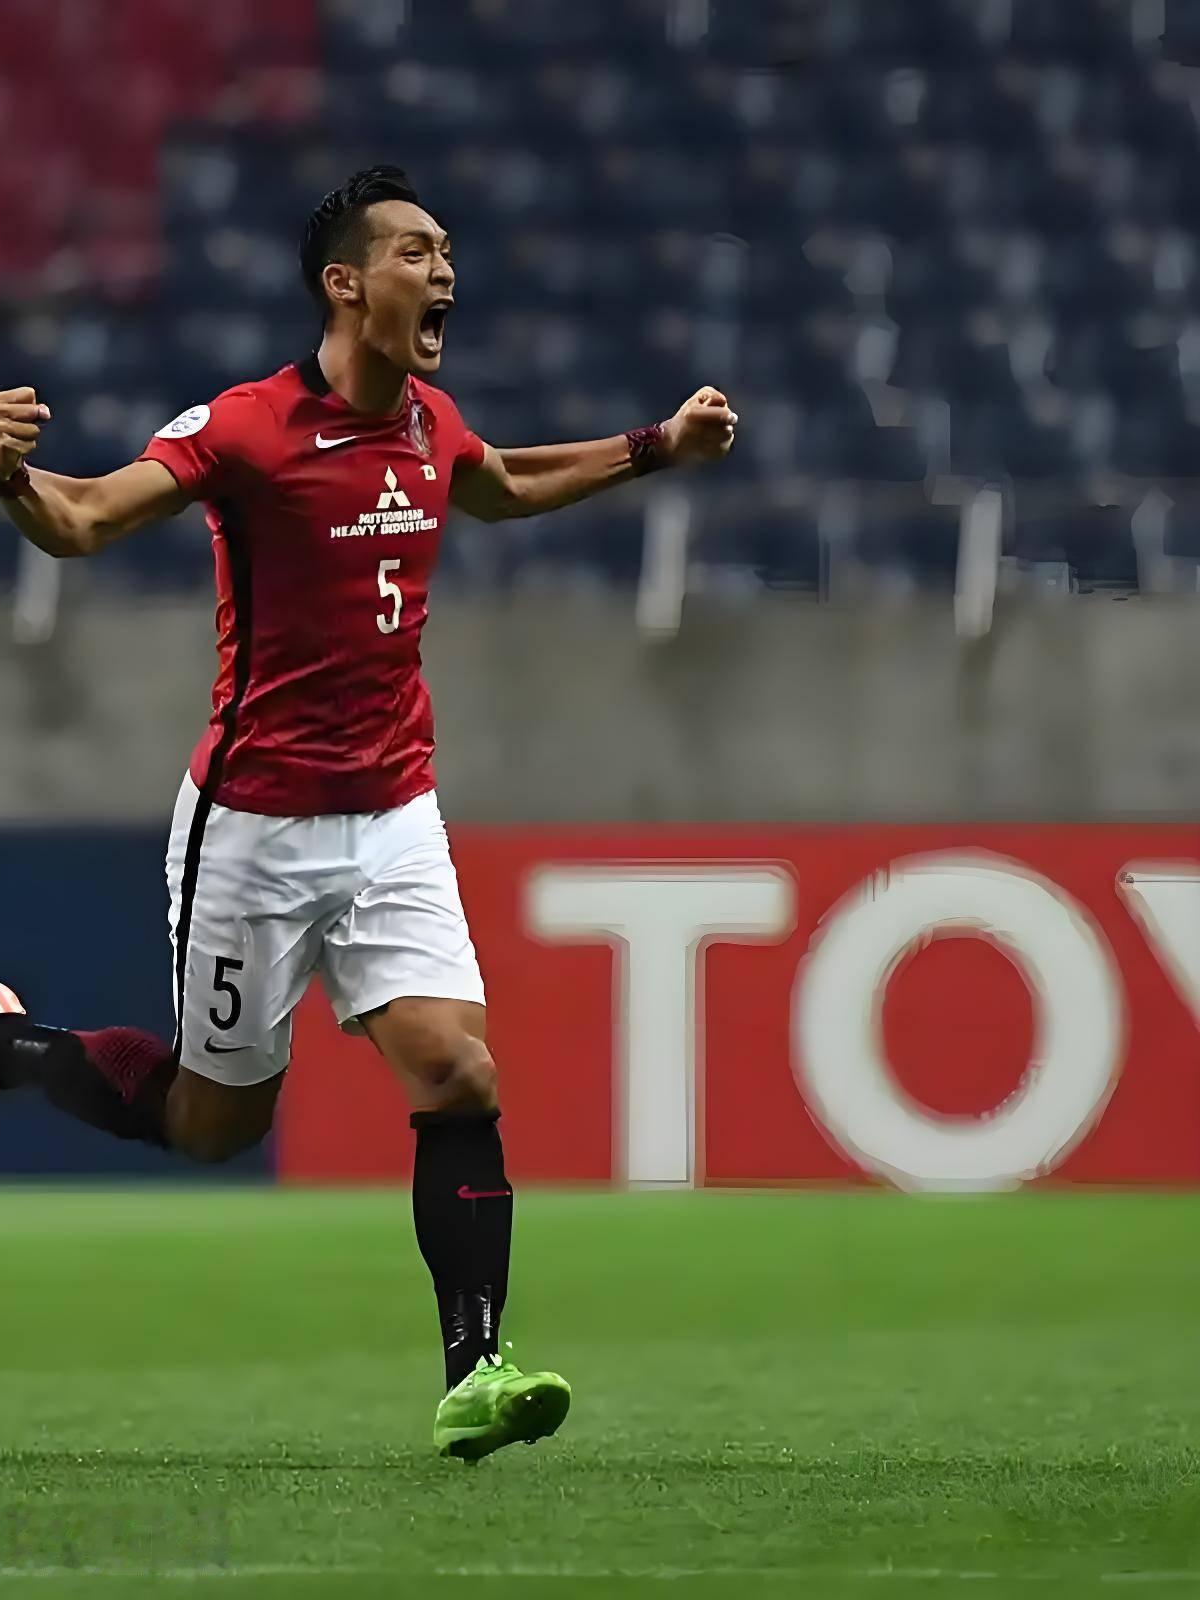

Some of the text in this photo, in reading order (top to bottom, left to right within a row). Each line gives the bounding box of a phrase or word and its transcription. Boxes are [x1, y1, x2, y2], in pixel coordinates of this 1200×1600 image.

[330, 525, 377, 538] HEAVY
[376, 558, 403, 634] 5
[209, 955, 244, 1031] 5
